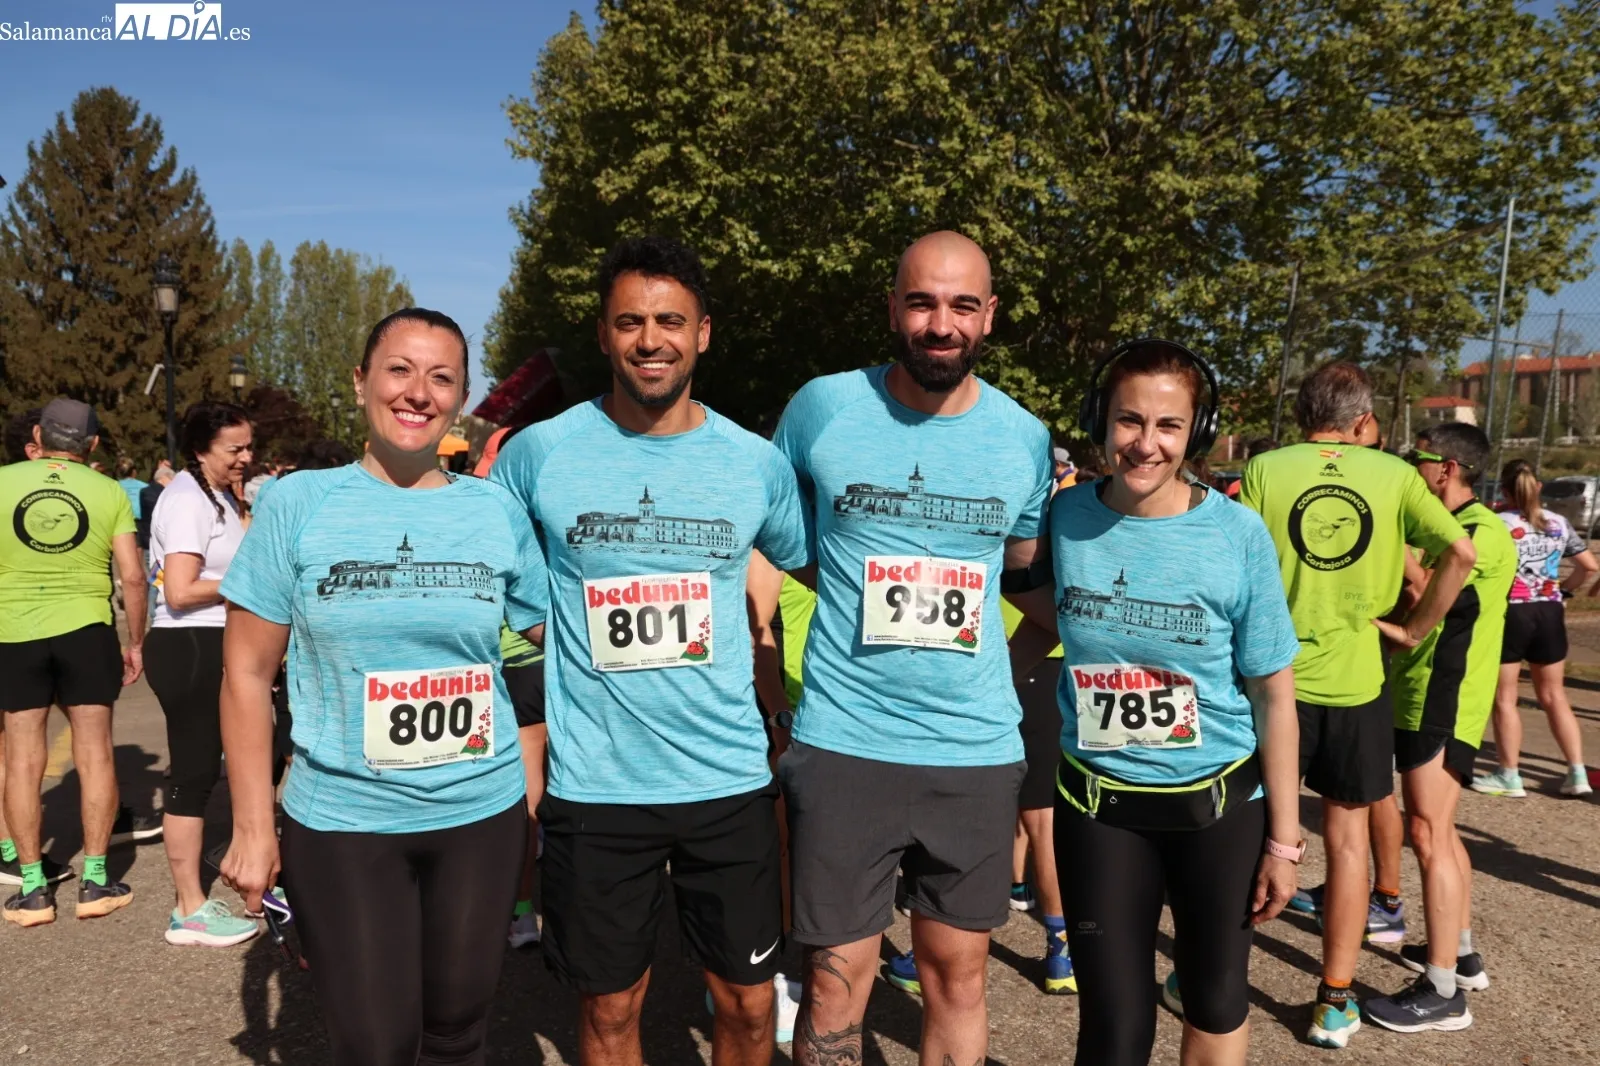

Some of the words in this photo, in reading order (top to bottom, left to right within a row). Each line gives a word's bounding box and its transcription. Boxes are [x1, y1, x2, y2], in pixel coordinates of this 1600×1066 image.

[20, 491, 84, 512] CORRECAMINOS
[1296, 488, 1369, 514] CORRECAMINOS
[29, 540, 74, 554] Carbajosa
[1305, 552, 1352, 570] Carbajosa
[587, 578, 709, 608] bedunia
[885, 584, 966, 628] 958
[607, 603, 688, 649] 801
[368, 670, 491, 702] bedunia
[389, 697, 473, 746] 800
[1093, 688, 1176, 731] 785
